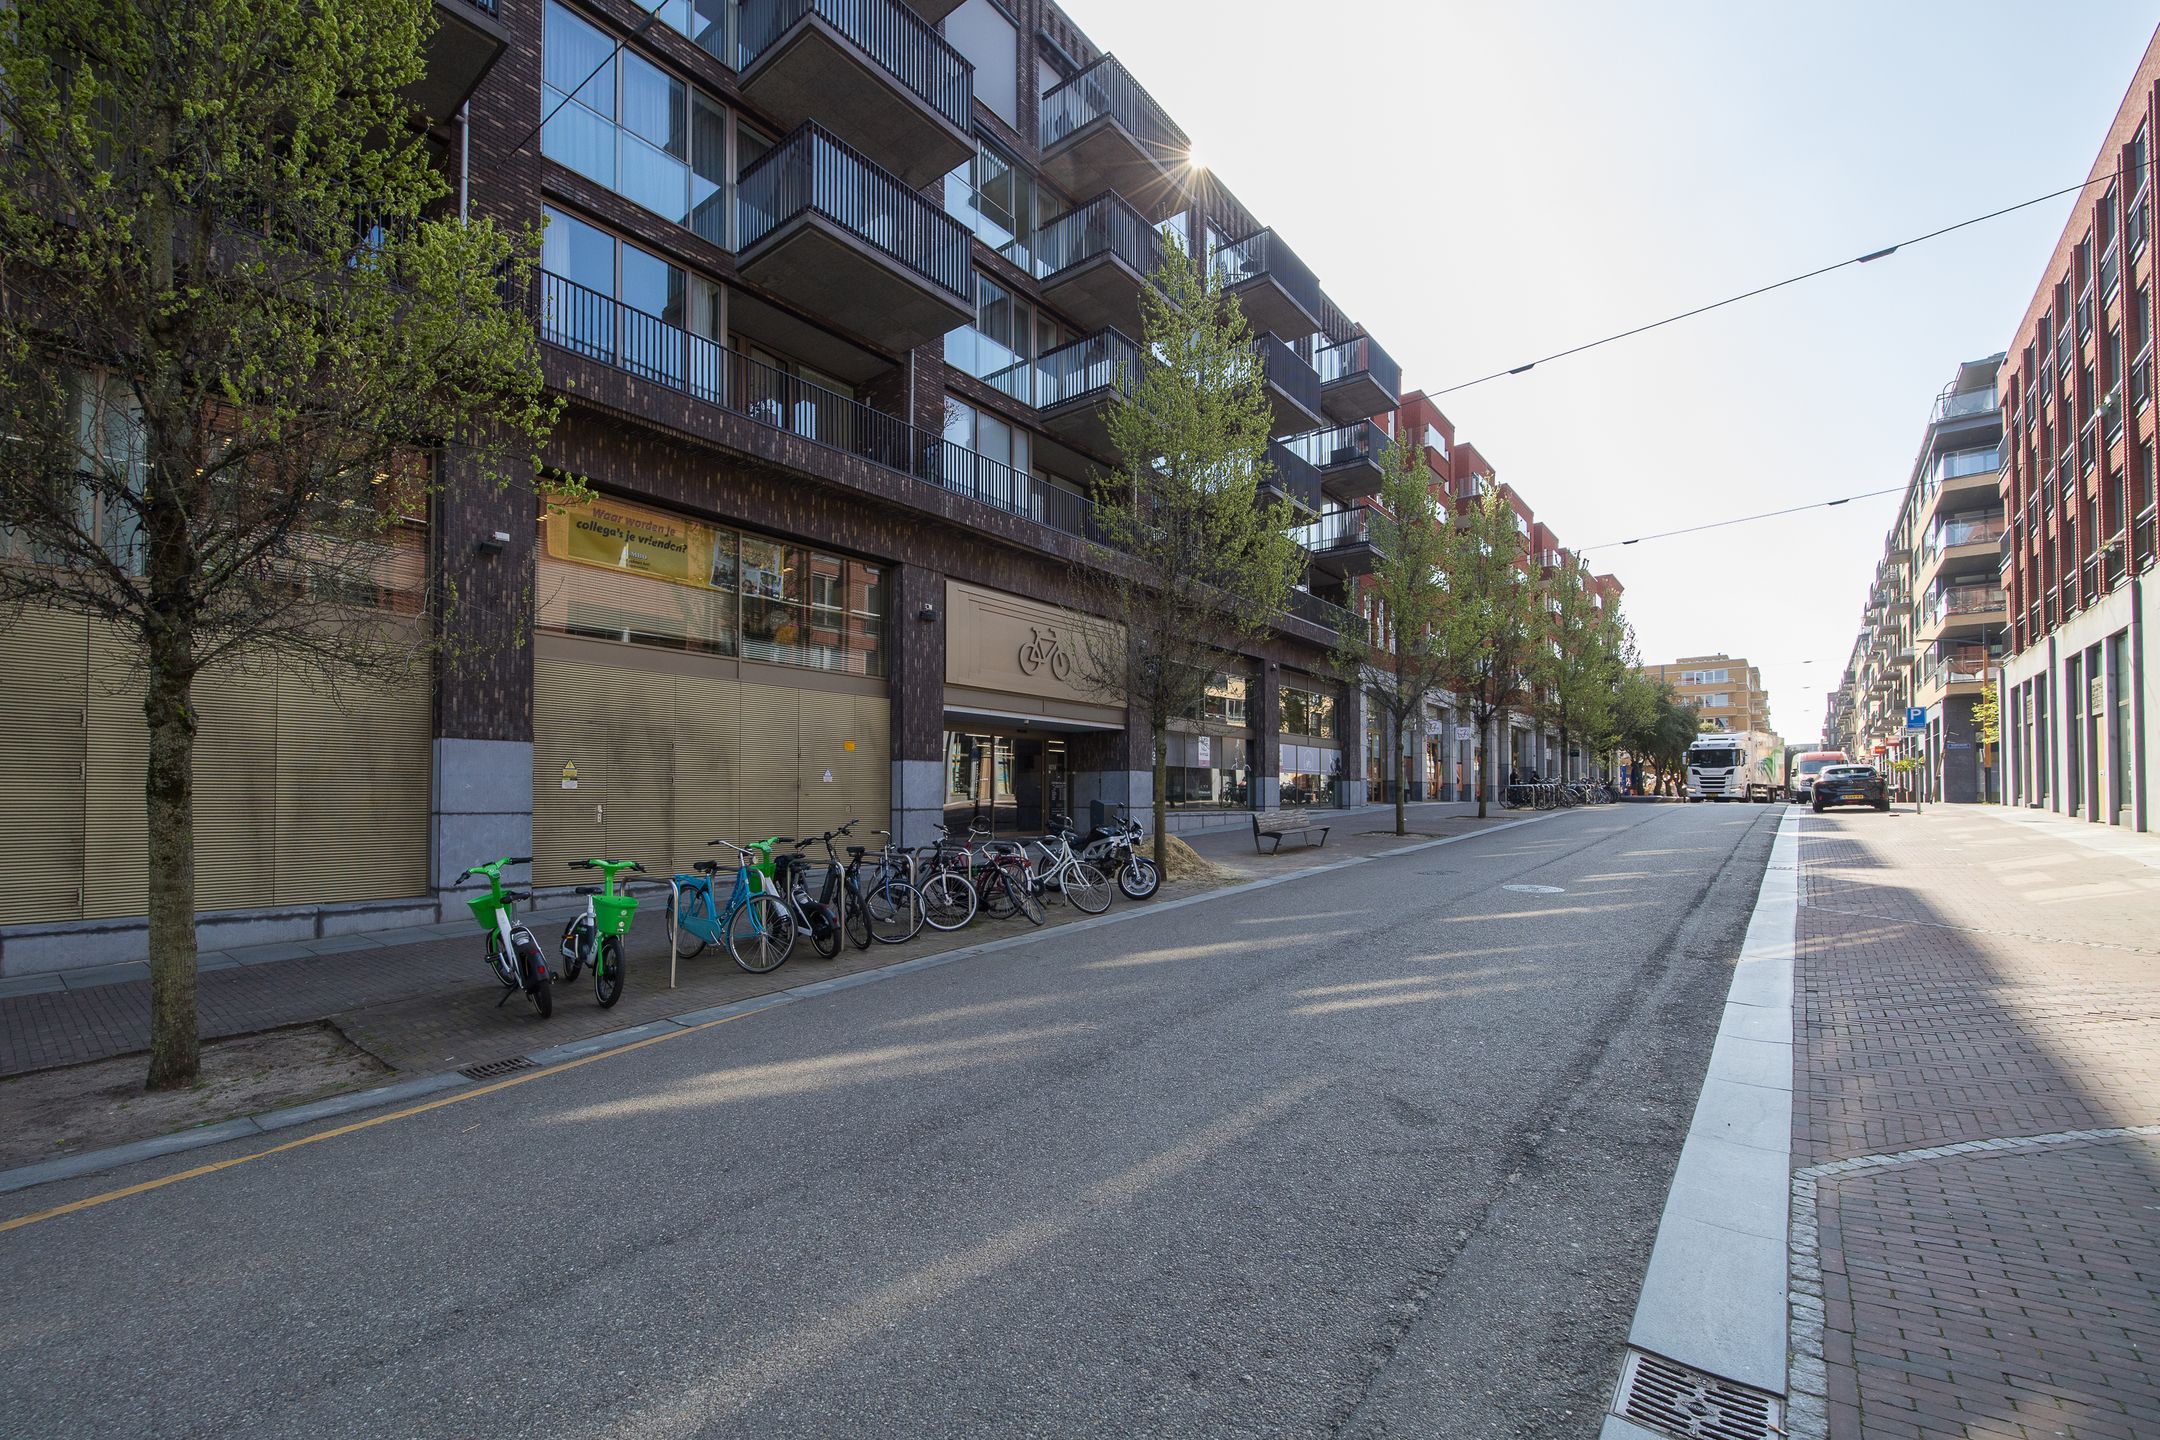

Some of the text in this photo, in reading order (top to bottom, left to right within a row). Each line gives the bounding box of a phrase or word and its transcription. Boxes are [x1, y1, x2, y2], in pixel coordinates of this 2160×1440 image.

[576, 520, 688, 553] collega's je vrienden?
[592, 507, 676, 537] Waar worden je
[1910, 709, 1922, 720] P
